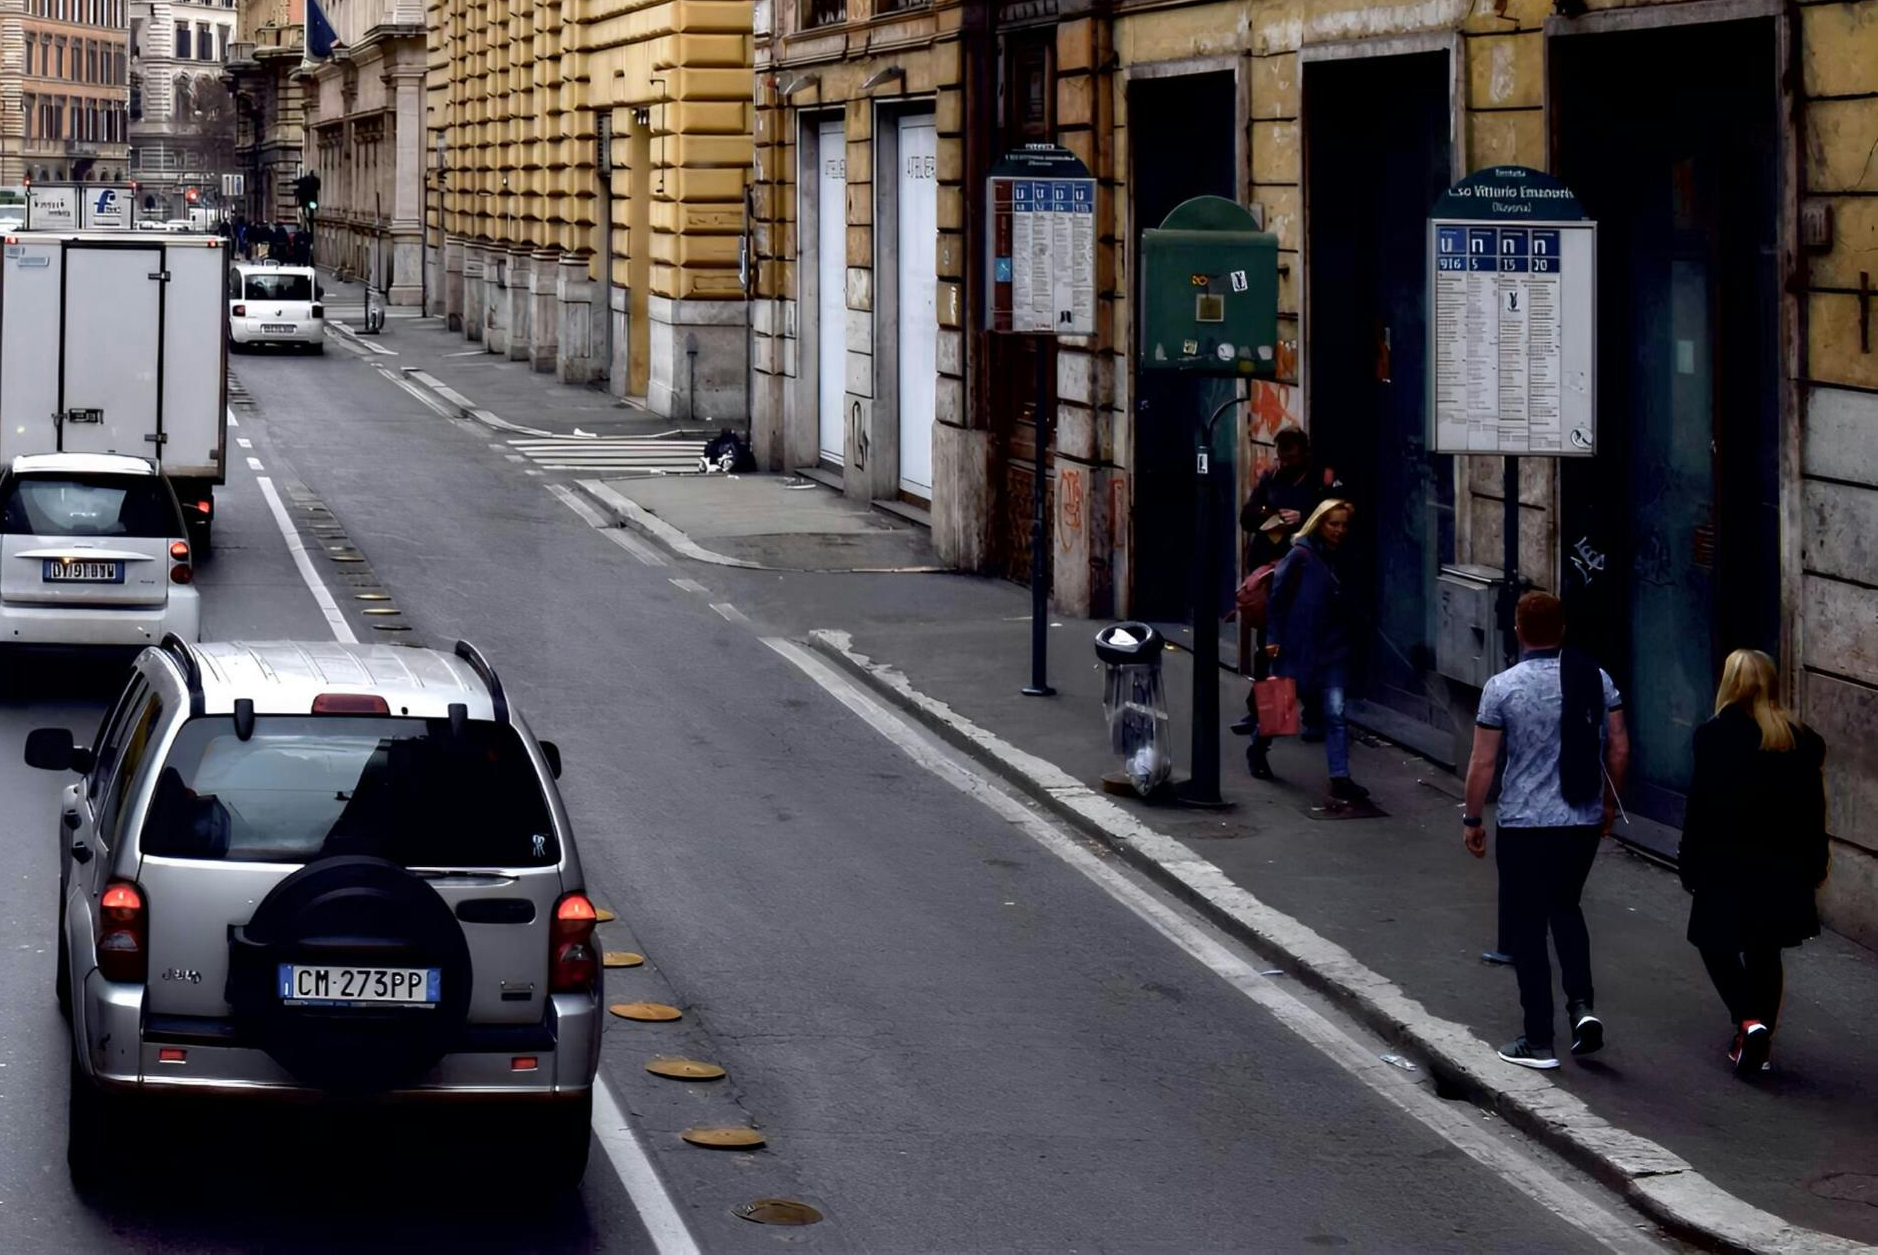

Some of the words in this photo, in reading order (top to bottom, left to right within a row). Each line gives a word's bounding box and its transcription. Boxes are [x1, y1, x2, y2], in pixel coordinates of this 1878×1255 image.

[1471, 238, 1484, 253] n
[1502, 238, 1515, 254] n
[1533, 239, 1546, 255] n
[1439, 258, 1462, 270] 916
[1471, 258, 1479, 270] 5
[1503, 258, 1516, 271] 15
[1533, 259, 1548, 271] 20
